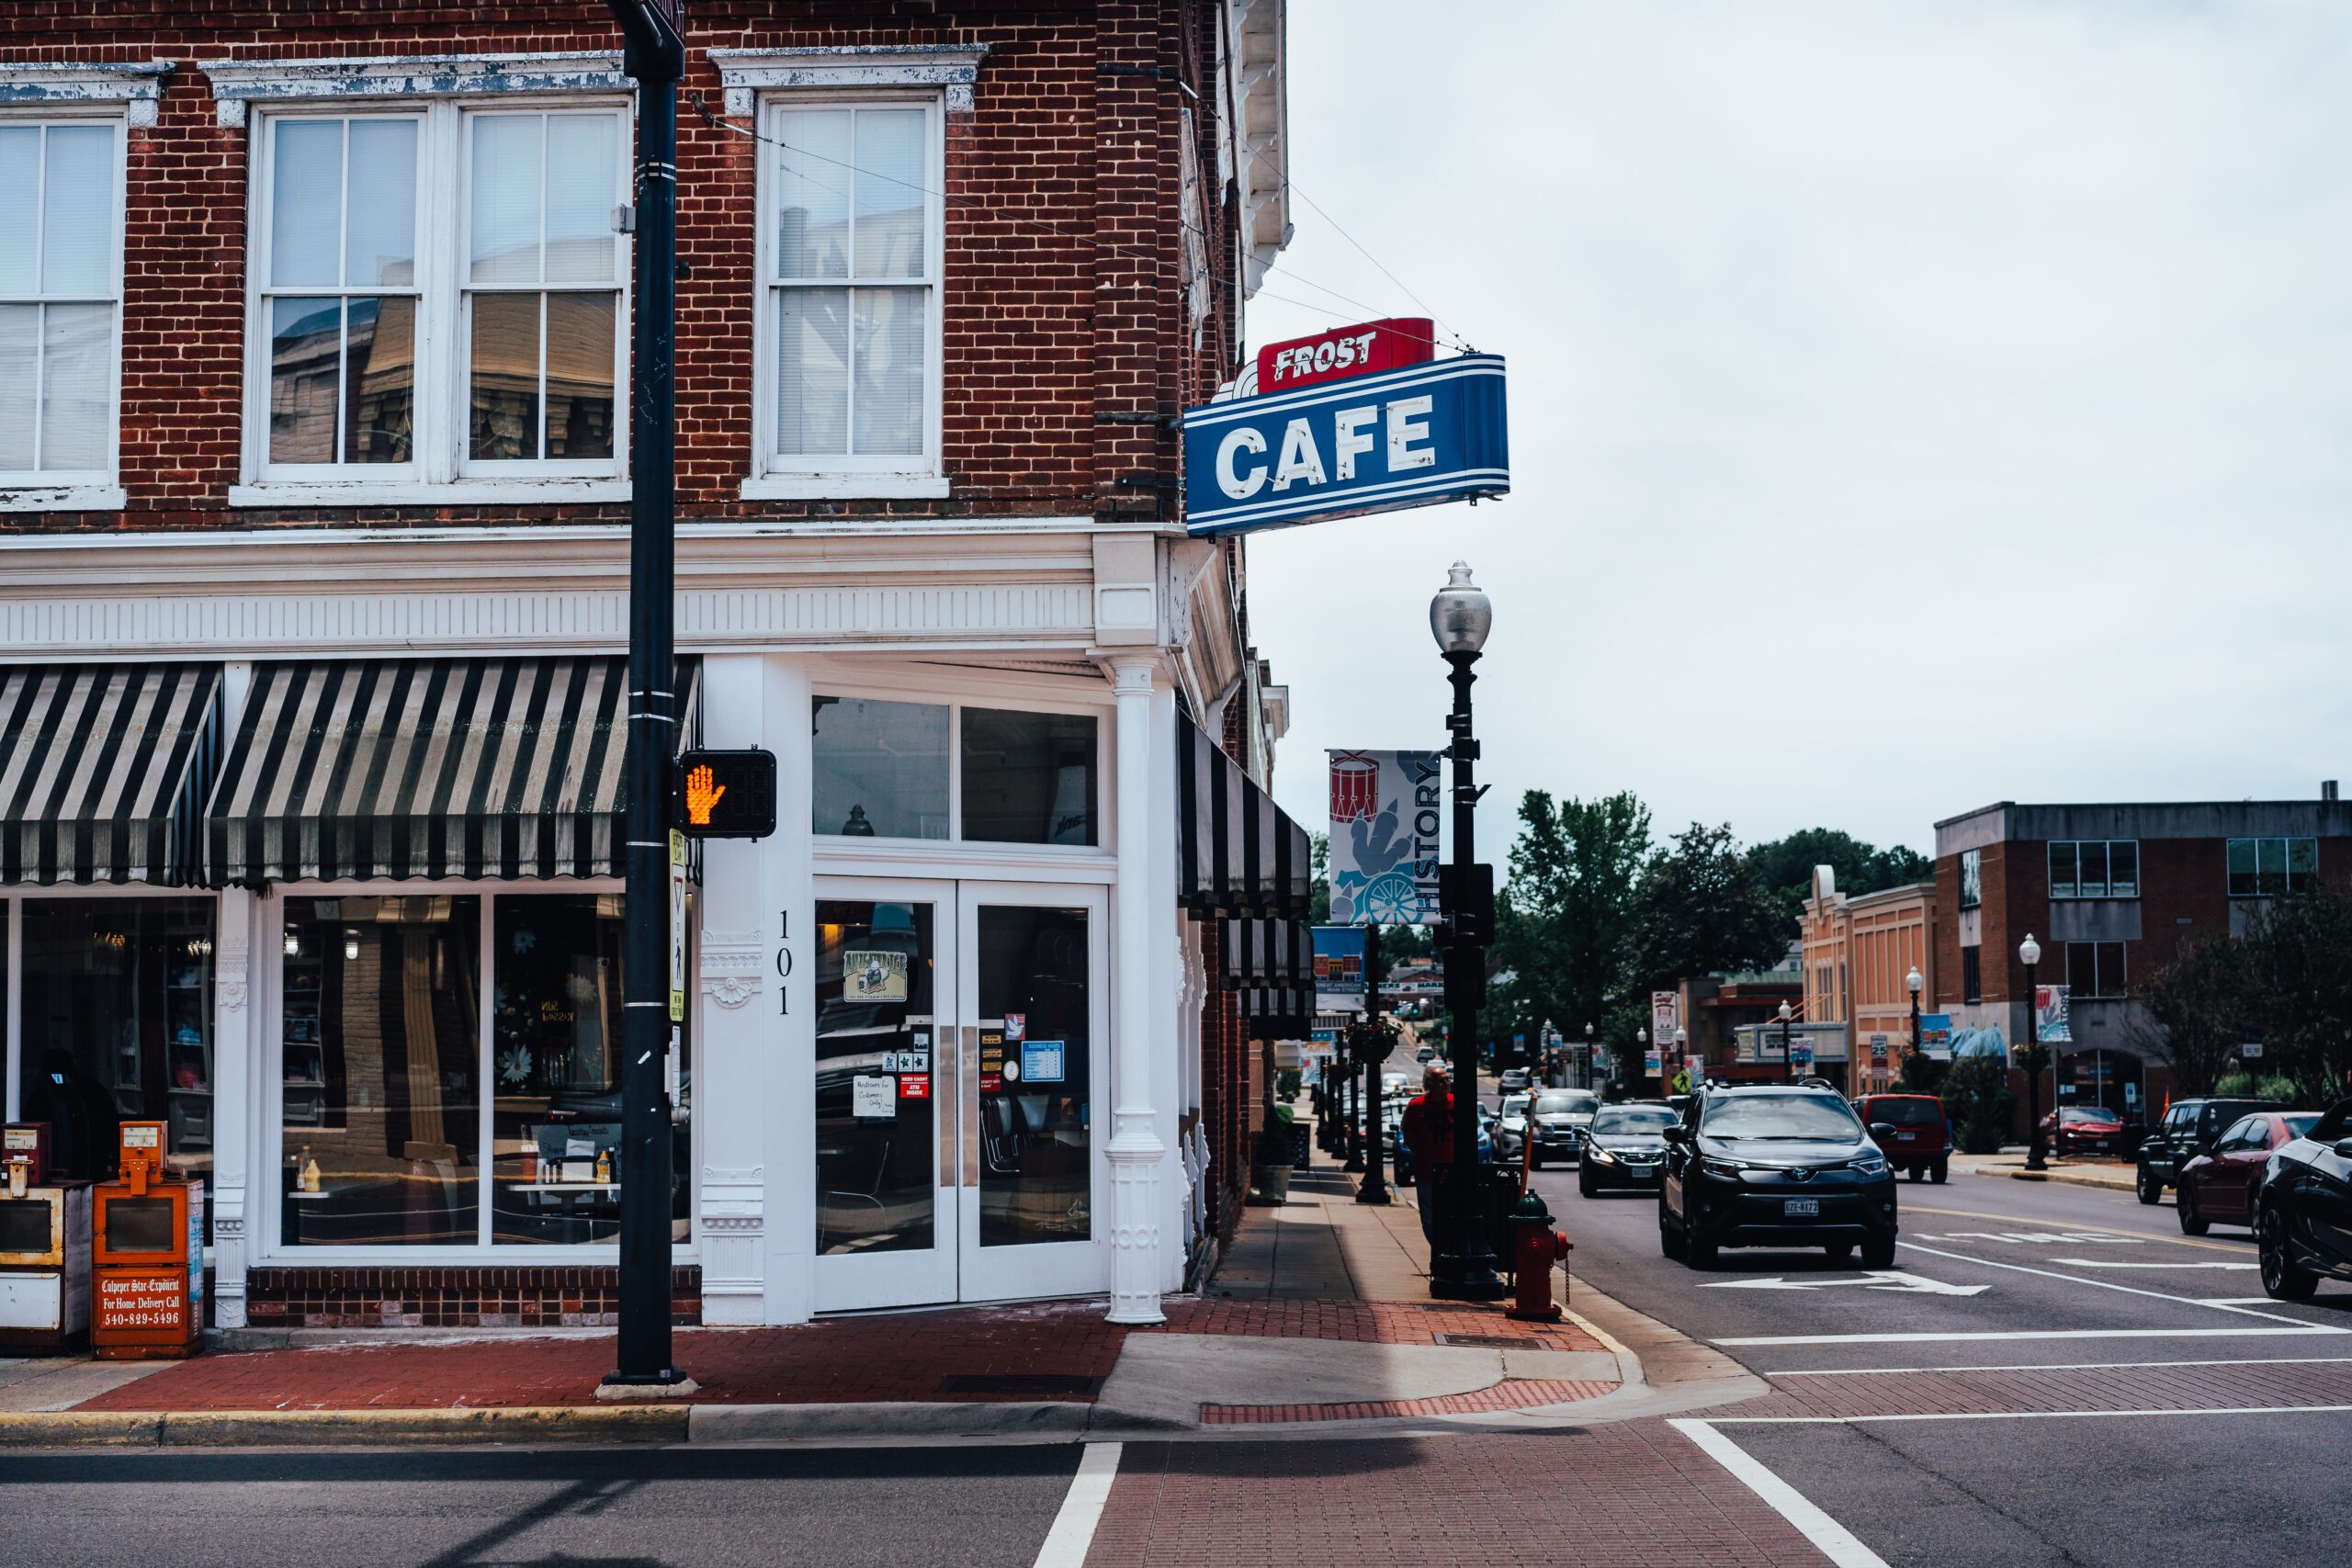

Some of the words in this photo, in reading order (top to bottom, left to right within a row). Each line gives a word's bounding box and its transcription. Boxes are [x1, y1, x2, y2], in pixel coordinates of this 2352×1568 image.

[1274, 331, 1376, 382] FROST
[1216, 395, 1435, 500] CAFE
[1415, 761, 1440, 913] HISTORY
[776, 909, 792, 1015] 101
[2060, 990, 2070, 1038] HISTORY
[1872, 1046, 1886, 1055] 25
[102, 1279, 130, 1294] Culpeper
[103, 1298, 115, 1309] For
[116, 1297, 135, 1309] Home
[138, 1296, 164, 1312] Delivery
[166, 1295, 179, 1308] Call
[105, 1312, 179, 1325] 540-829-5496
